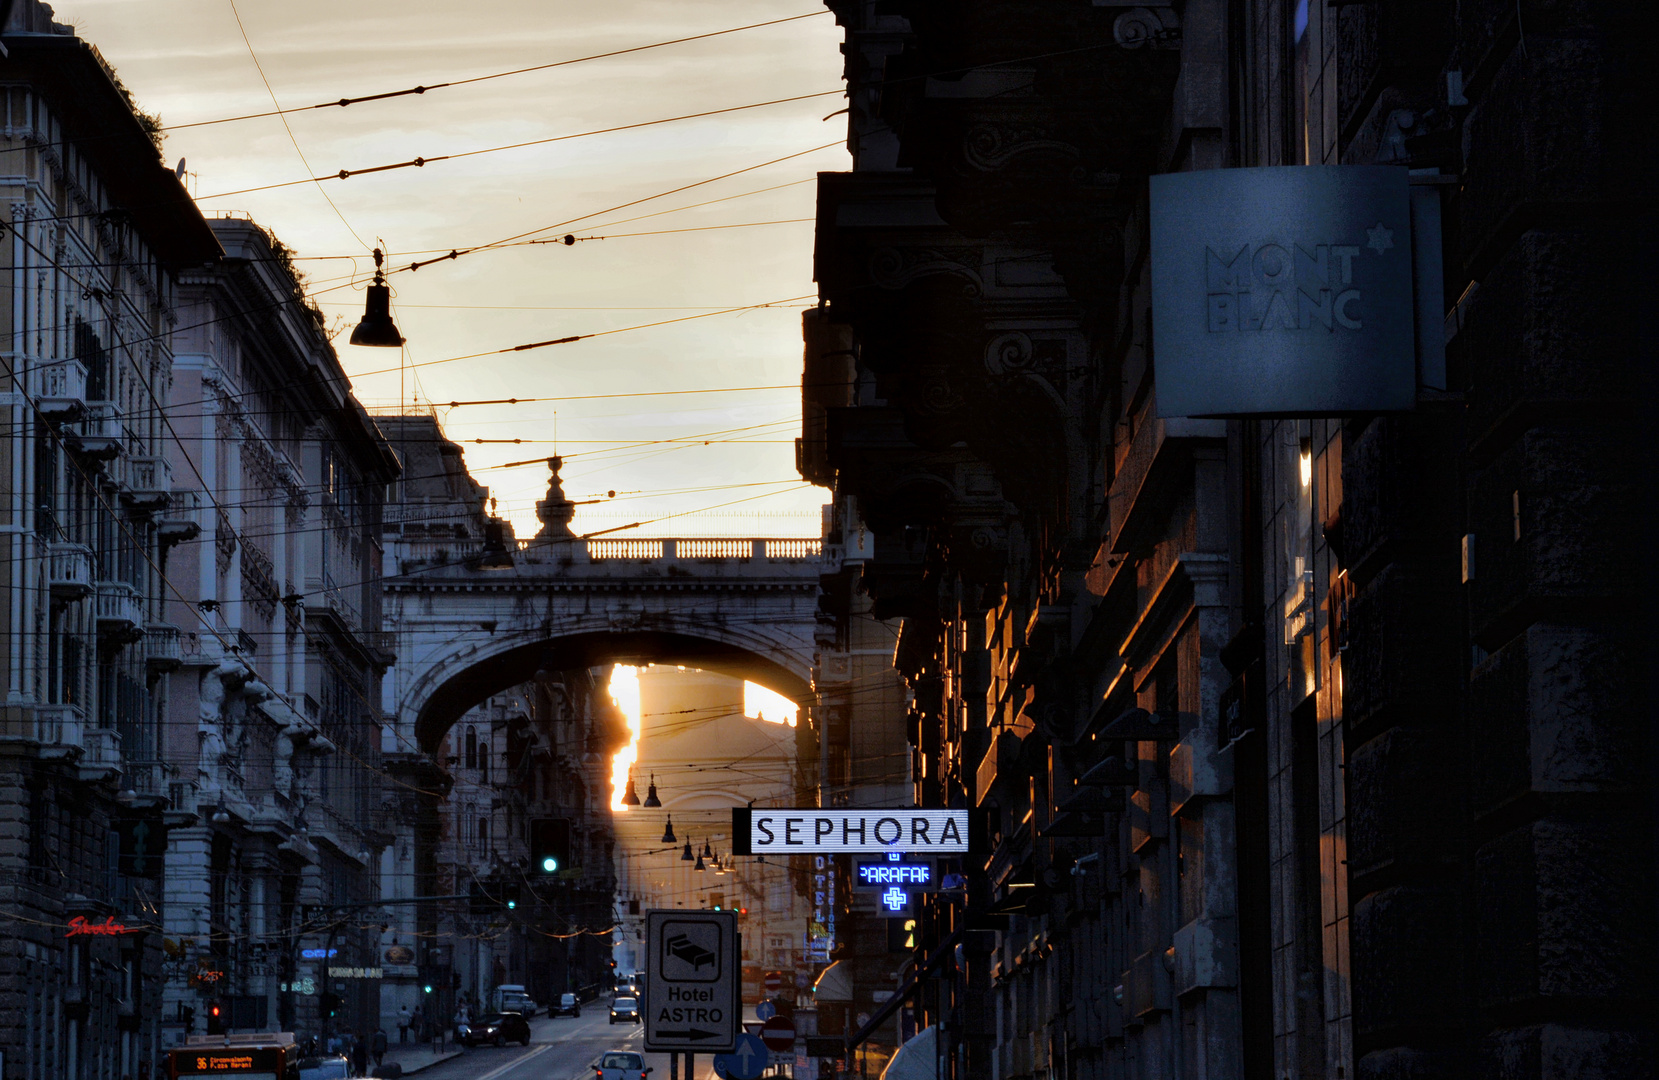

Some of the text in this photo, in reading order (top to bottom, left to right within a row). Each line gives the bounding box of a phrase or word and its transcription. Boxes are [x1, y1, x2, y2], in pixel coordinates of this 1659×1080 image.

[1205, 243, 1359, 289] MONT
[1207, 289, 1363, 333] BLANC
[756, 817, 963, 846] SEPHORA
[668, 986, 714, 1002] Hotel
[658, 1008, 723, 1023] ASTRO
[196, 1057, 208, 1070] 36
